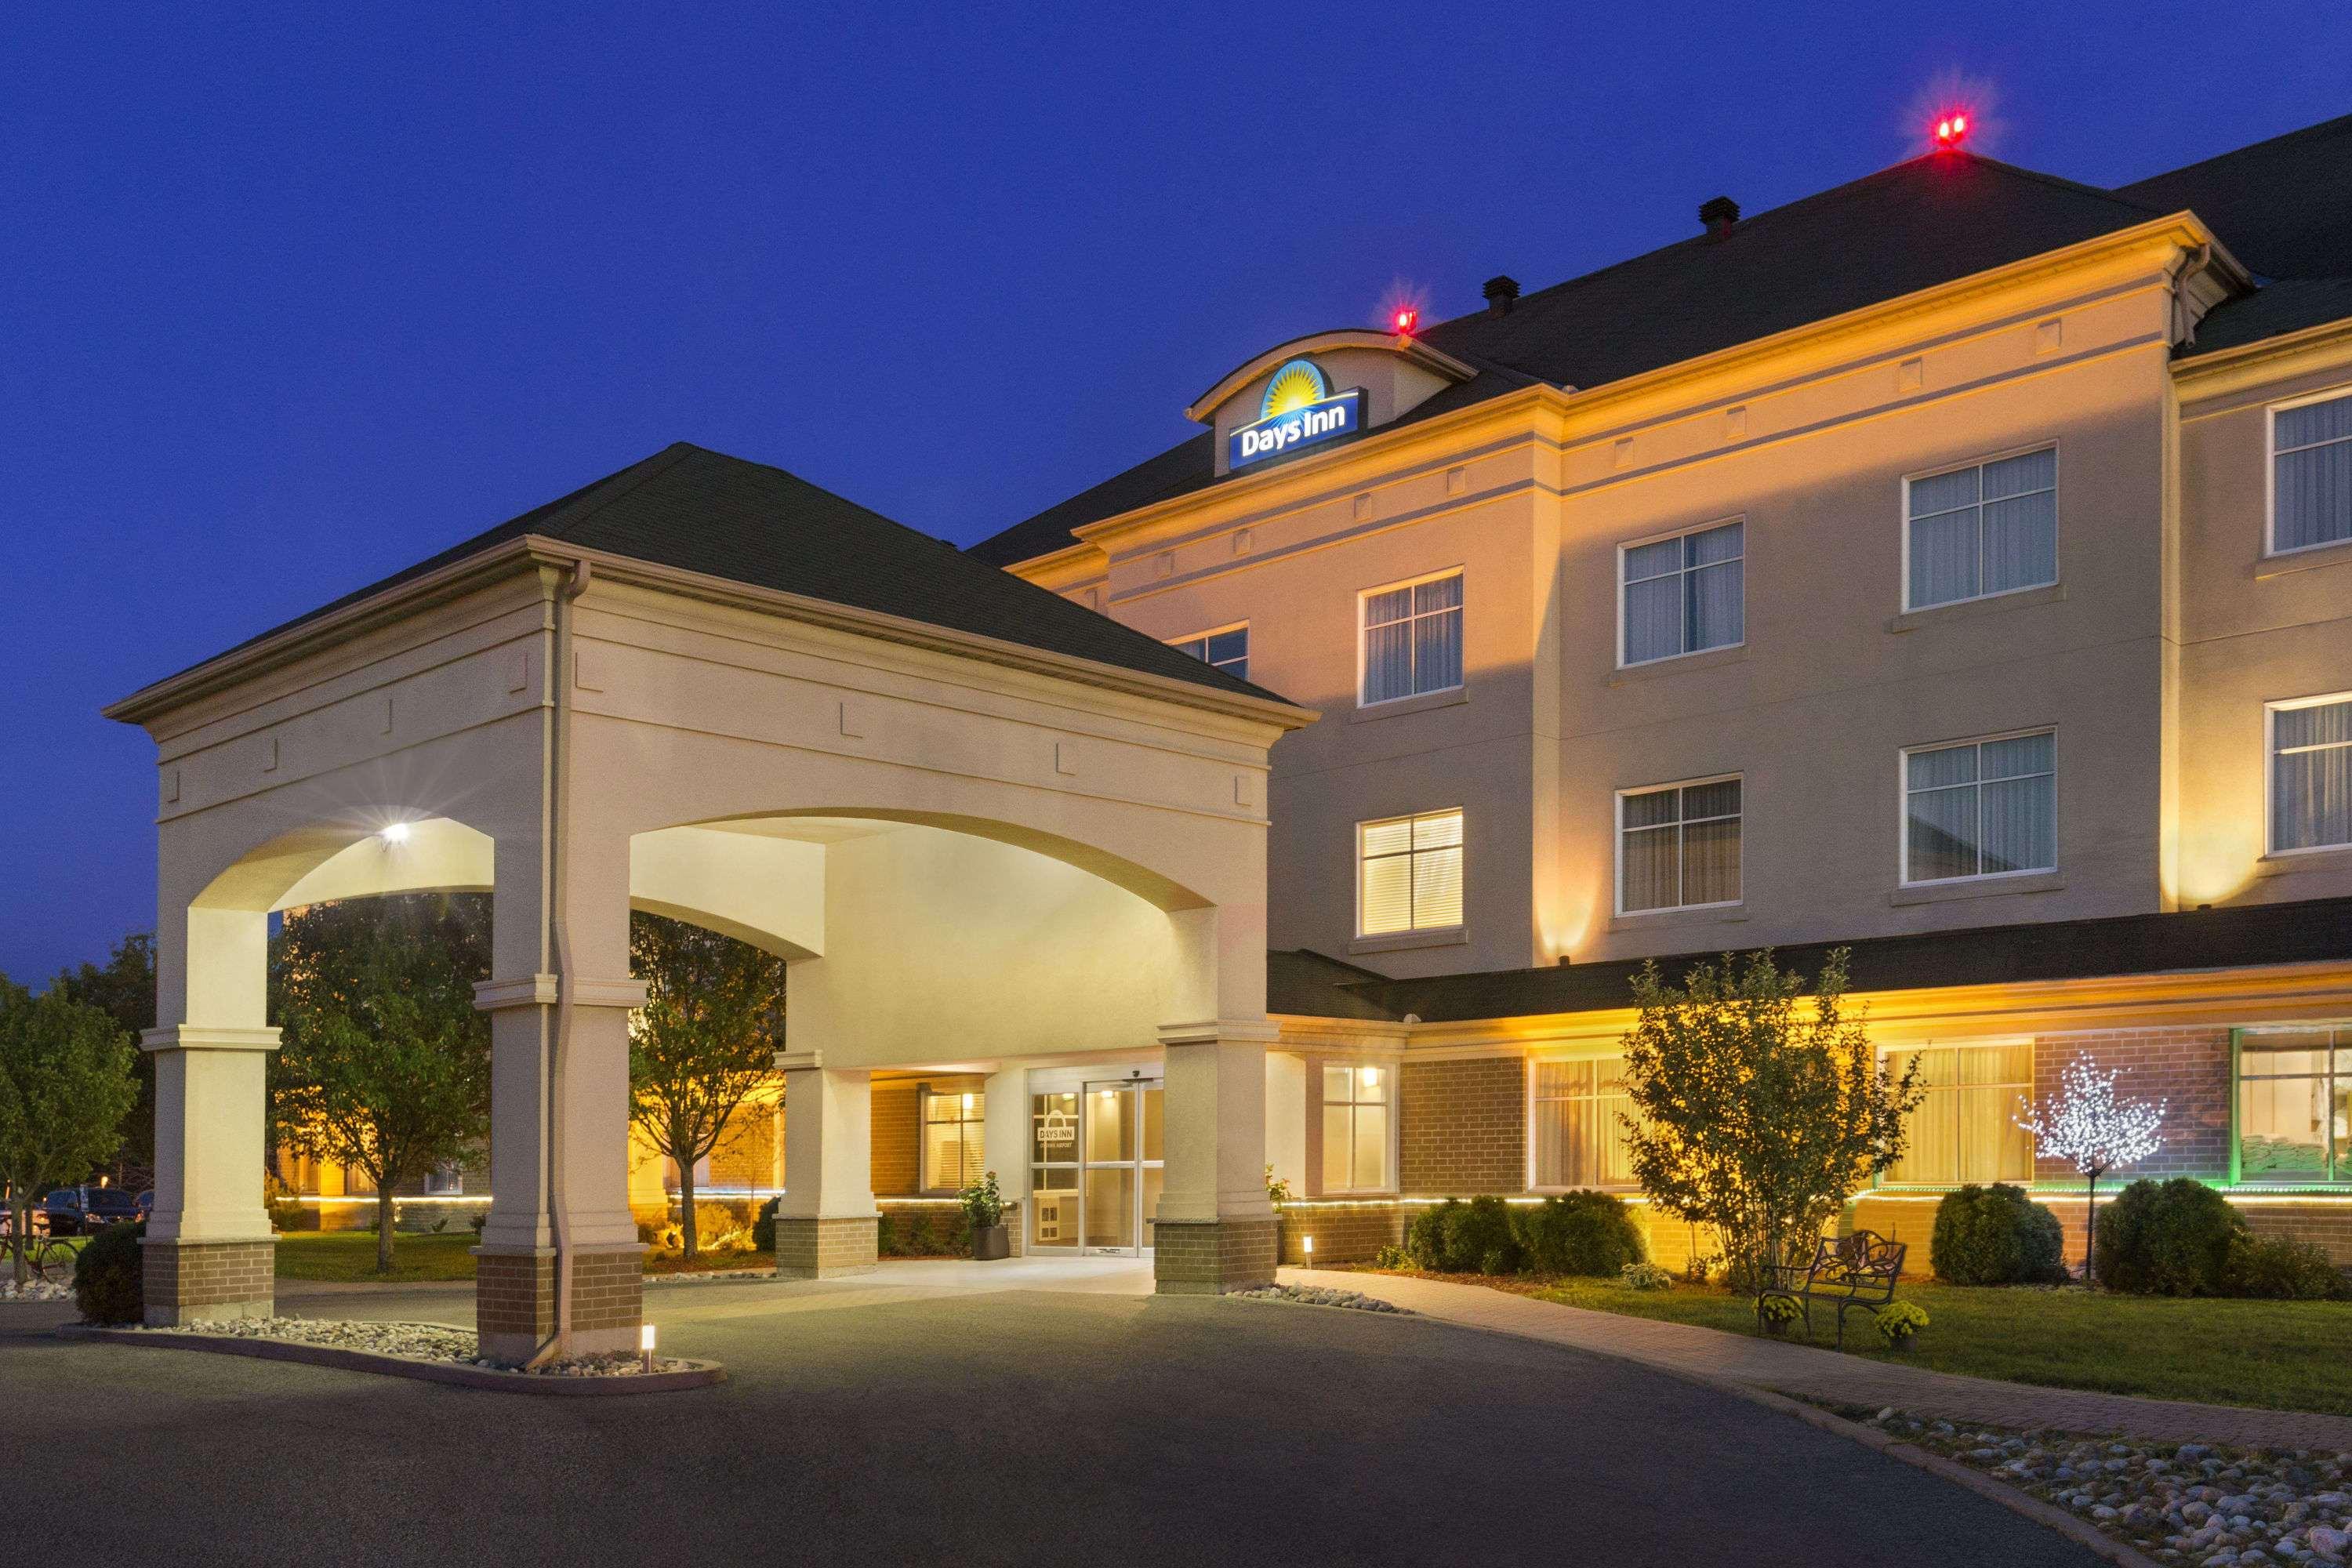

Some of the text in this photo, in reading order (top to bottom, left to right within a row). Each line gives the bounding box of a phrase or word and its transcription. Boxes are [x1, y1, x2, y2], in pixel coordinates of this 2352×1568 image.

[1242, 406, 1345, 457] Days Inn
[1040, 1129, 1073, 1138] DAYS INN
